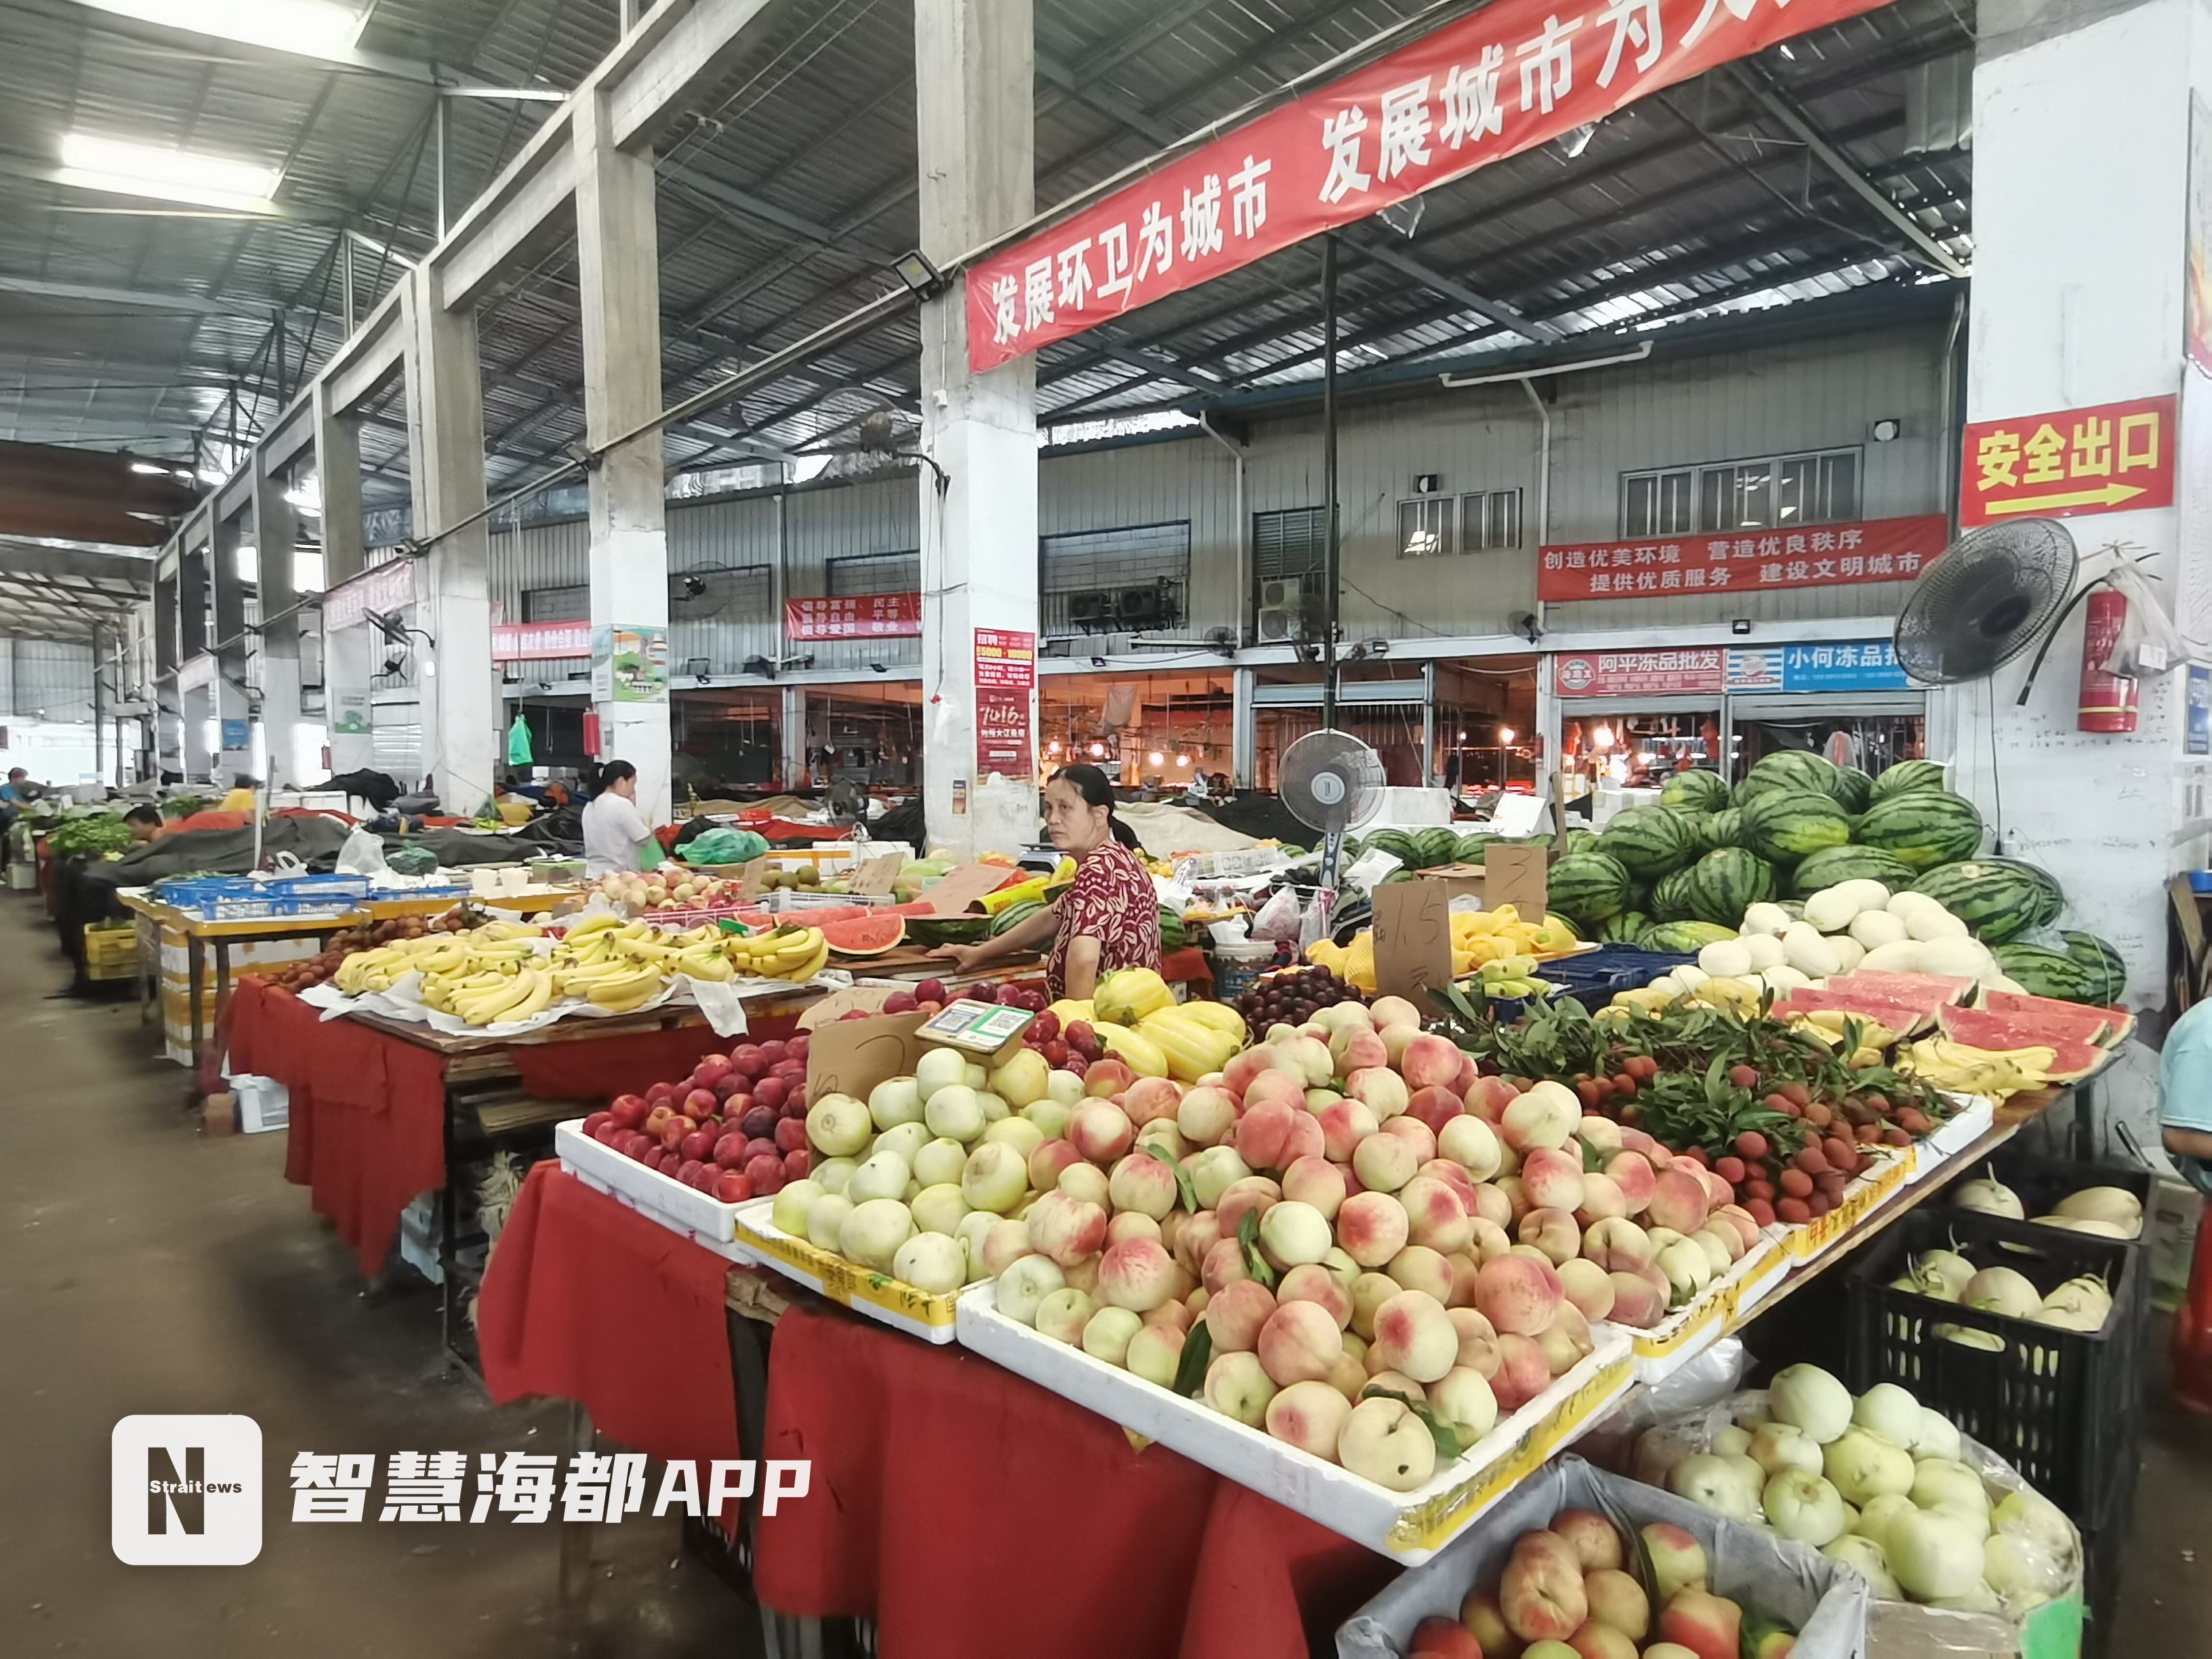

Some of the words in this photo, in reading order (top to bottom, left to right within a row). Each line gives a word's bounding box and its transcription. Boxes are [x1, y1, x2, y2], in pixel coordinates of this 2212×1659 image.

[992, 155, 1271, 344] 发展环卫为城市
[1976, 412, 2159, 491] 安全出口
[1544, 545, 1681, 569] 创造优美环境
[1707, 529, 1863, 560] 营造优良秩序
[1590, 567, 1732, 592] 提供优质服务
[1759, 551, 1922, 583] 建设文明城市
[1598, 650, 1721, 673] 阿平冻品批发
